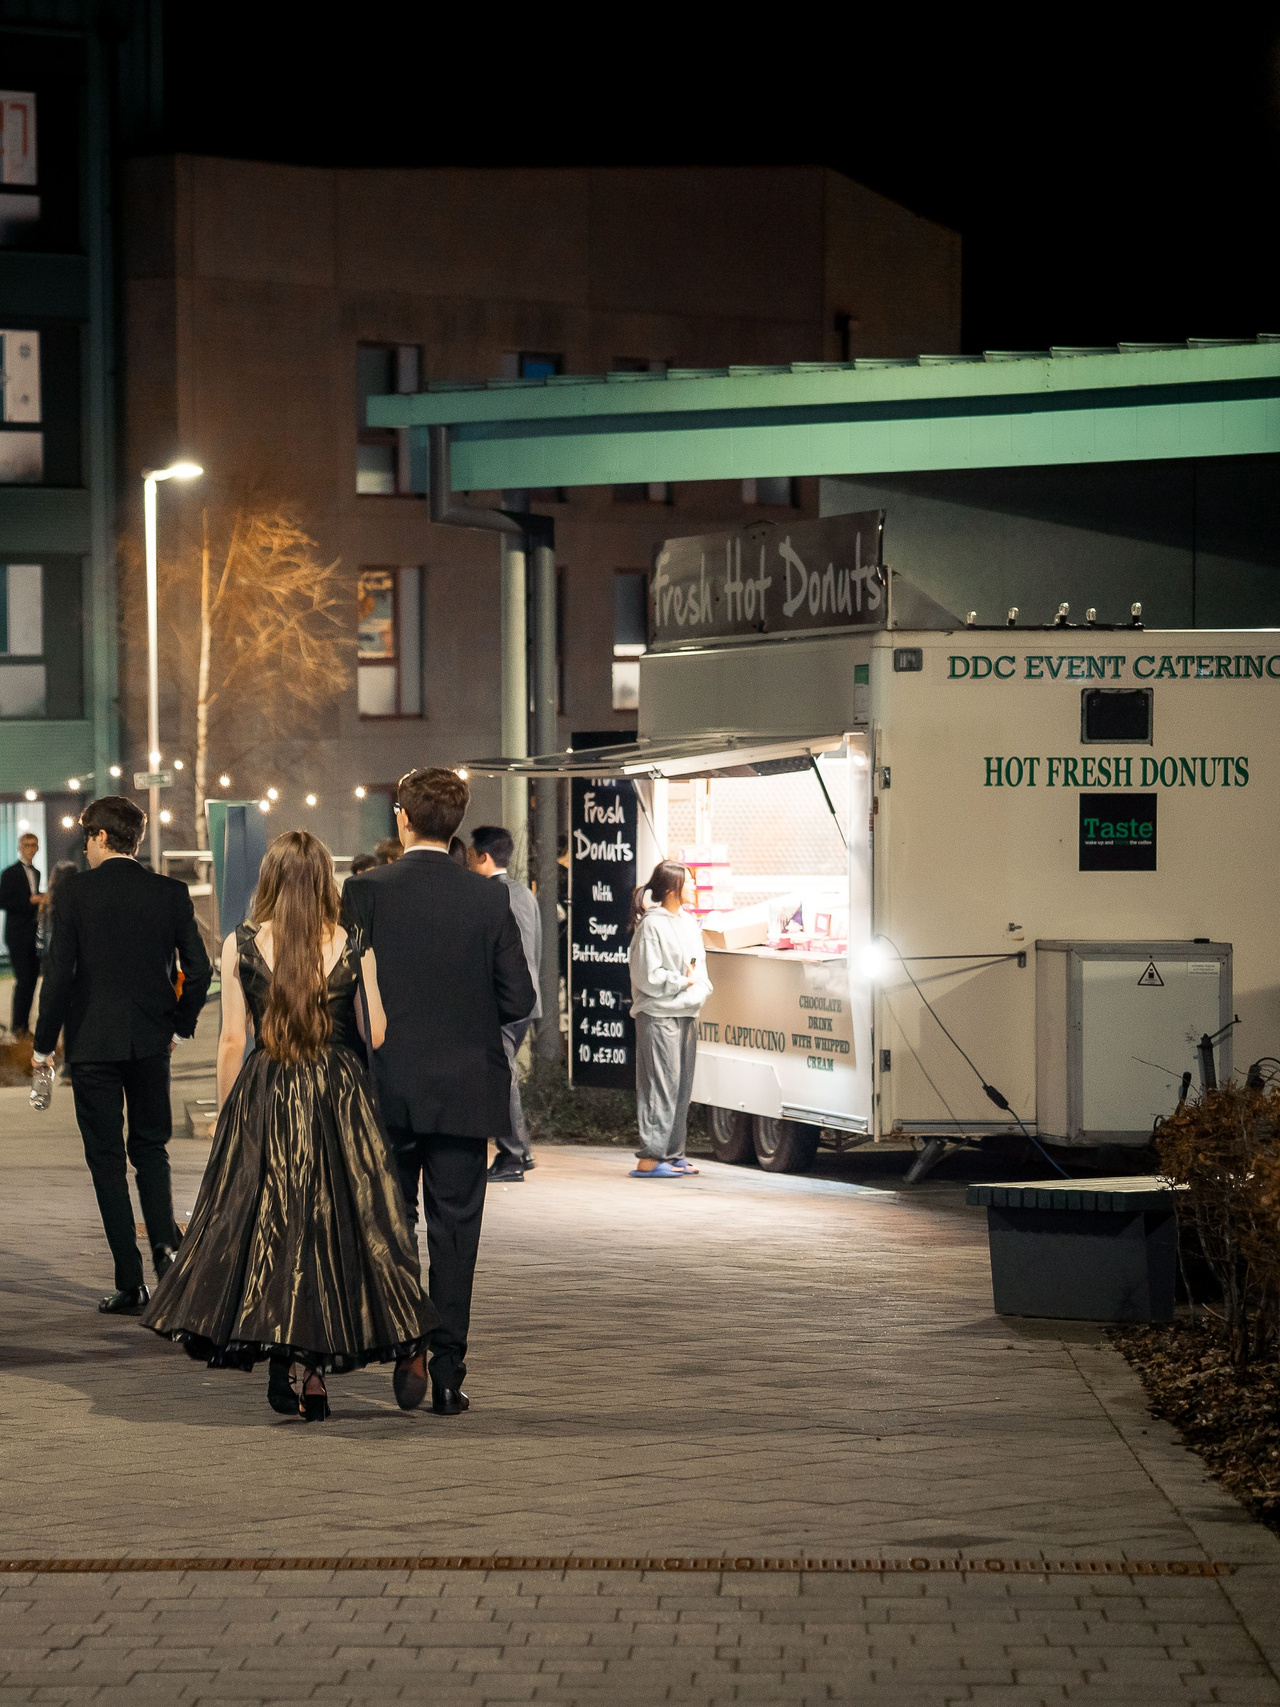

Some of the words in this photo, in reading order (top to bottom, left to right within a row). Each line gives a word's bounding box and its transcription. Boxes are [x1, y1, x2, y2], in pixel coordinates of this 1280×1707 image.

[654, 551, 713, 627] Fresh
[724, 537, 771, 622] Hot
[778, 531, 881, 618] Donuts
[947, 655, 1016, 679] DDC
[1024, 655, 1126, 679] EVENT
[983, 756, 1040, 787] HOT
[1045, 756, 1132, 787] FRESH
[1140, 756, 1250, 787] DONUTS
[583, 791, 625, 824] Fresh
[573, 828, 634, 862] Donuts
[592, 881, 613, 902] With
[588, 916, 618, 941] Sugar
[581, 988, 587, 1008] 1
[799, 995, 842, 1013] CHOCOLATE
[579, 1017, 589, 1035] 4
[808, 1015, 833, 1031] DRINK
[724, 1024, 786, 1053] CAPPUCCINO
[791, 1033, 812, 1049] WITH
[814, 1036, 850, 1054] WHIPPED
[578, 1043, 591, 1063] 10
[807, 1055, 834, 1072] CREAM
